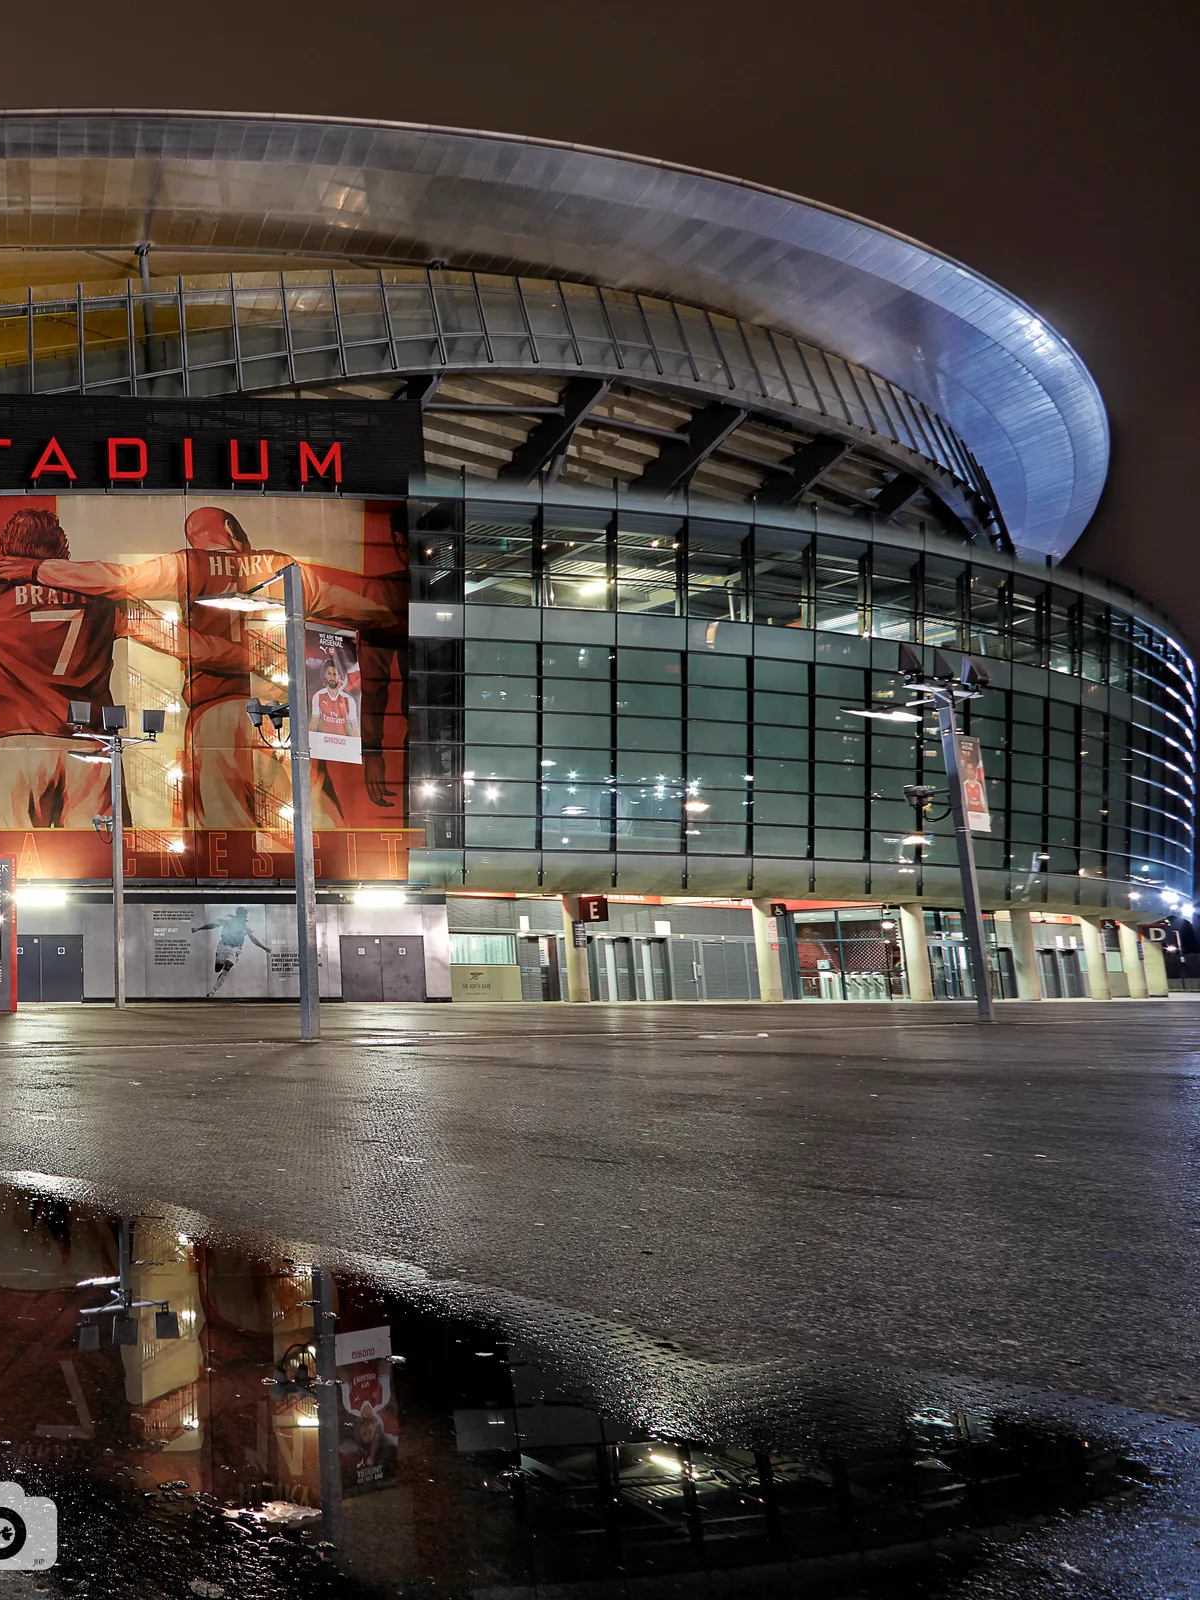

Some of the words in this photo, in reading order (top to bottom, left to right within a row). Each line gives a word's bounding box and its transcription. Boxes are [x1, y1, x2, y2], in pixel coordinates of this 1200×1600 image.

[209, 554, 276, 578] HENRY
[30, 608, 85, 677] 7
[320, 638, 344, 648] ARSENAL
[323, 714, 345, 724] Emirates
[324, 736, 347, 746] GIROUD
[589, 901, 600, 920] E
[1149, 927, 1166, 942] D
